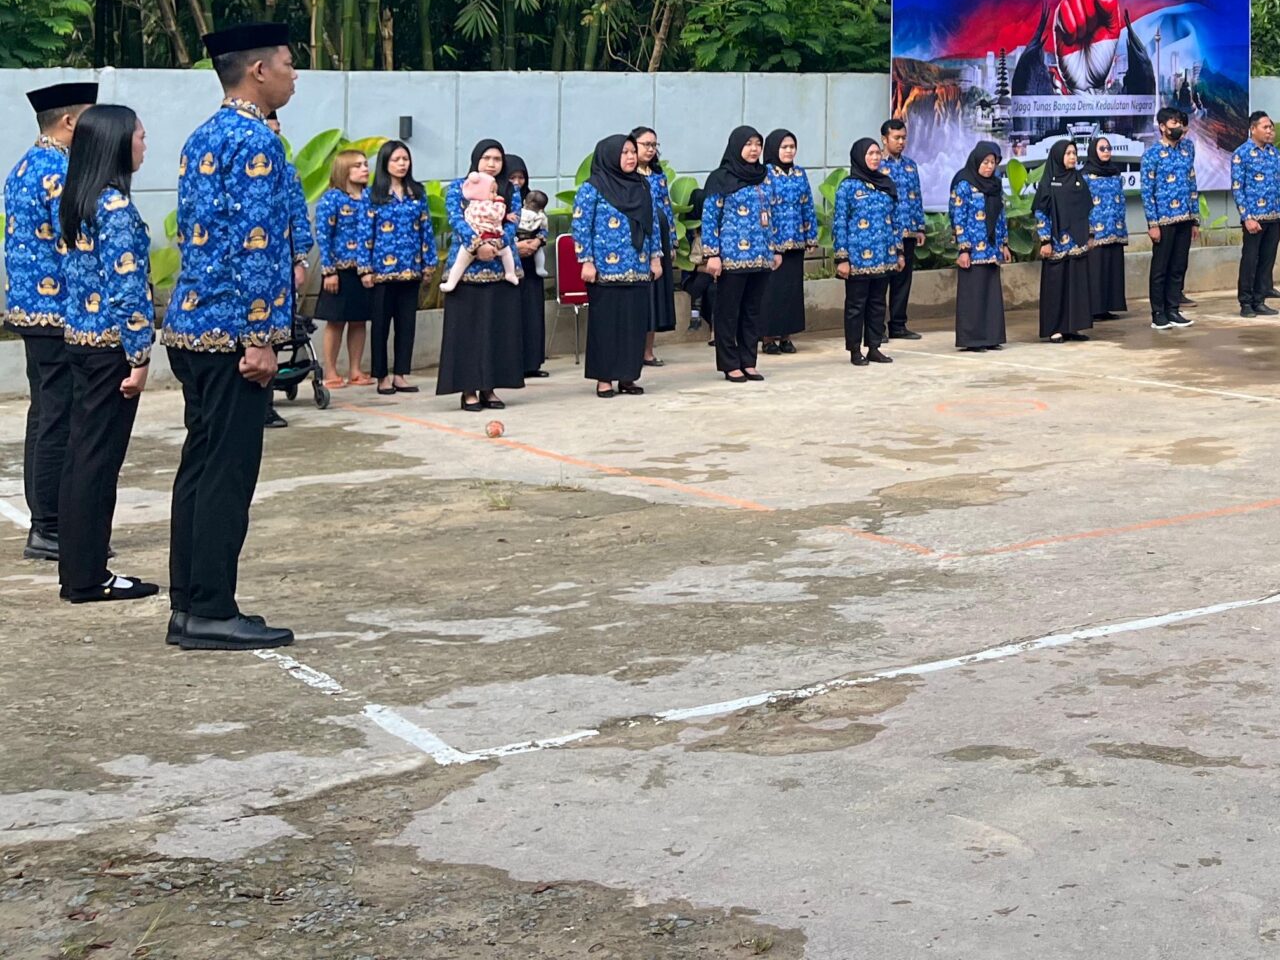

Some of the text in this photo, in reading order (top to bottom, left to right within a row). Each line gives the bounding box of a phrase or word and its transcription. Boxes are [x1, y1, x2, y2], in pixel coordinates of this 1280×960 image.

[1032, 100, 1052, 111] Tunas
[1053, 100, 1077, 113] Bangsa
[1095, 100, 1130, 111] Kedaulatan
